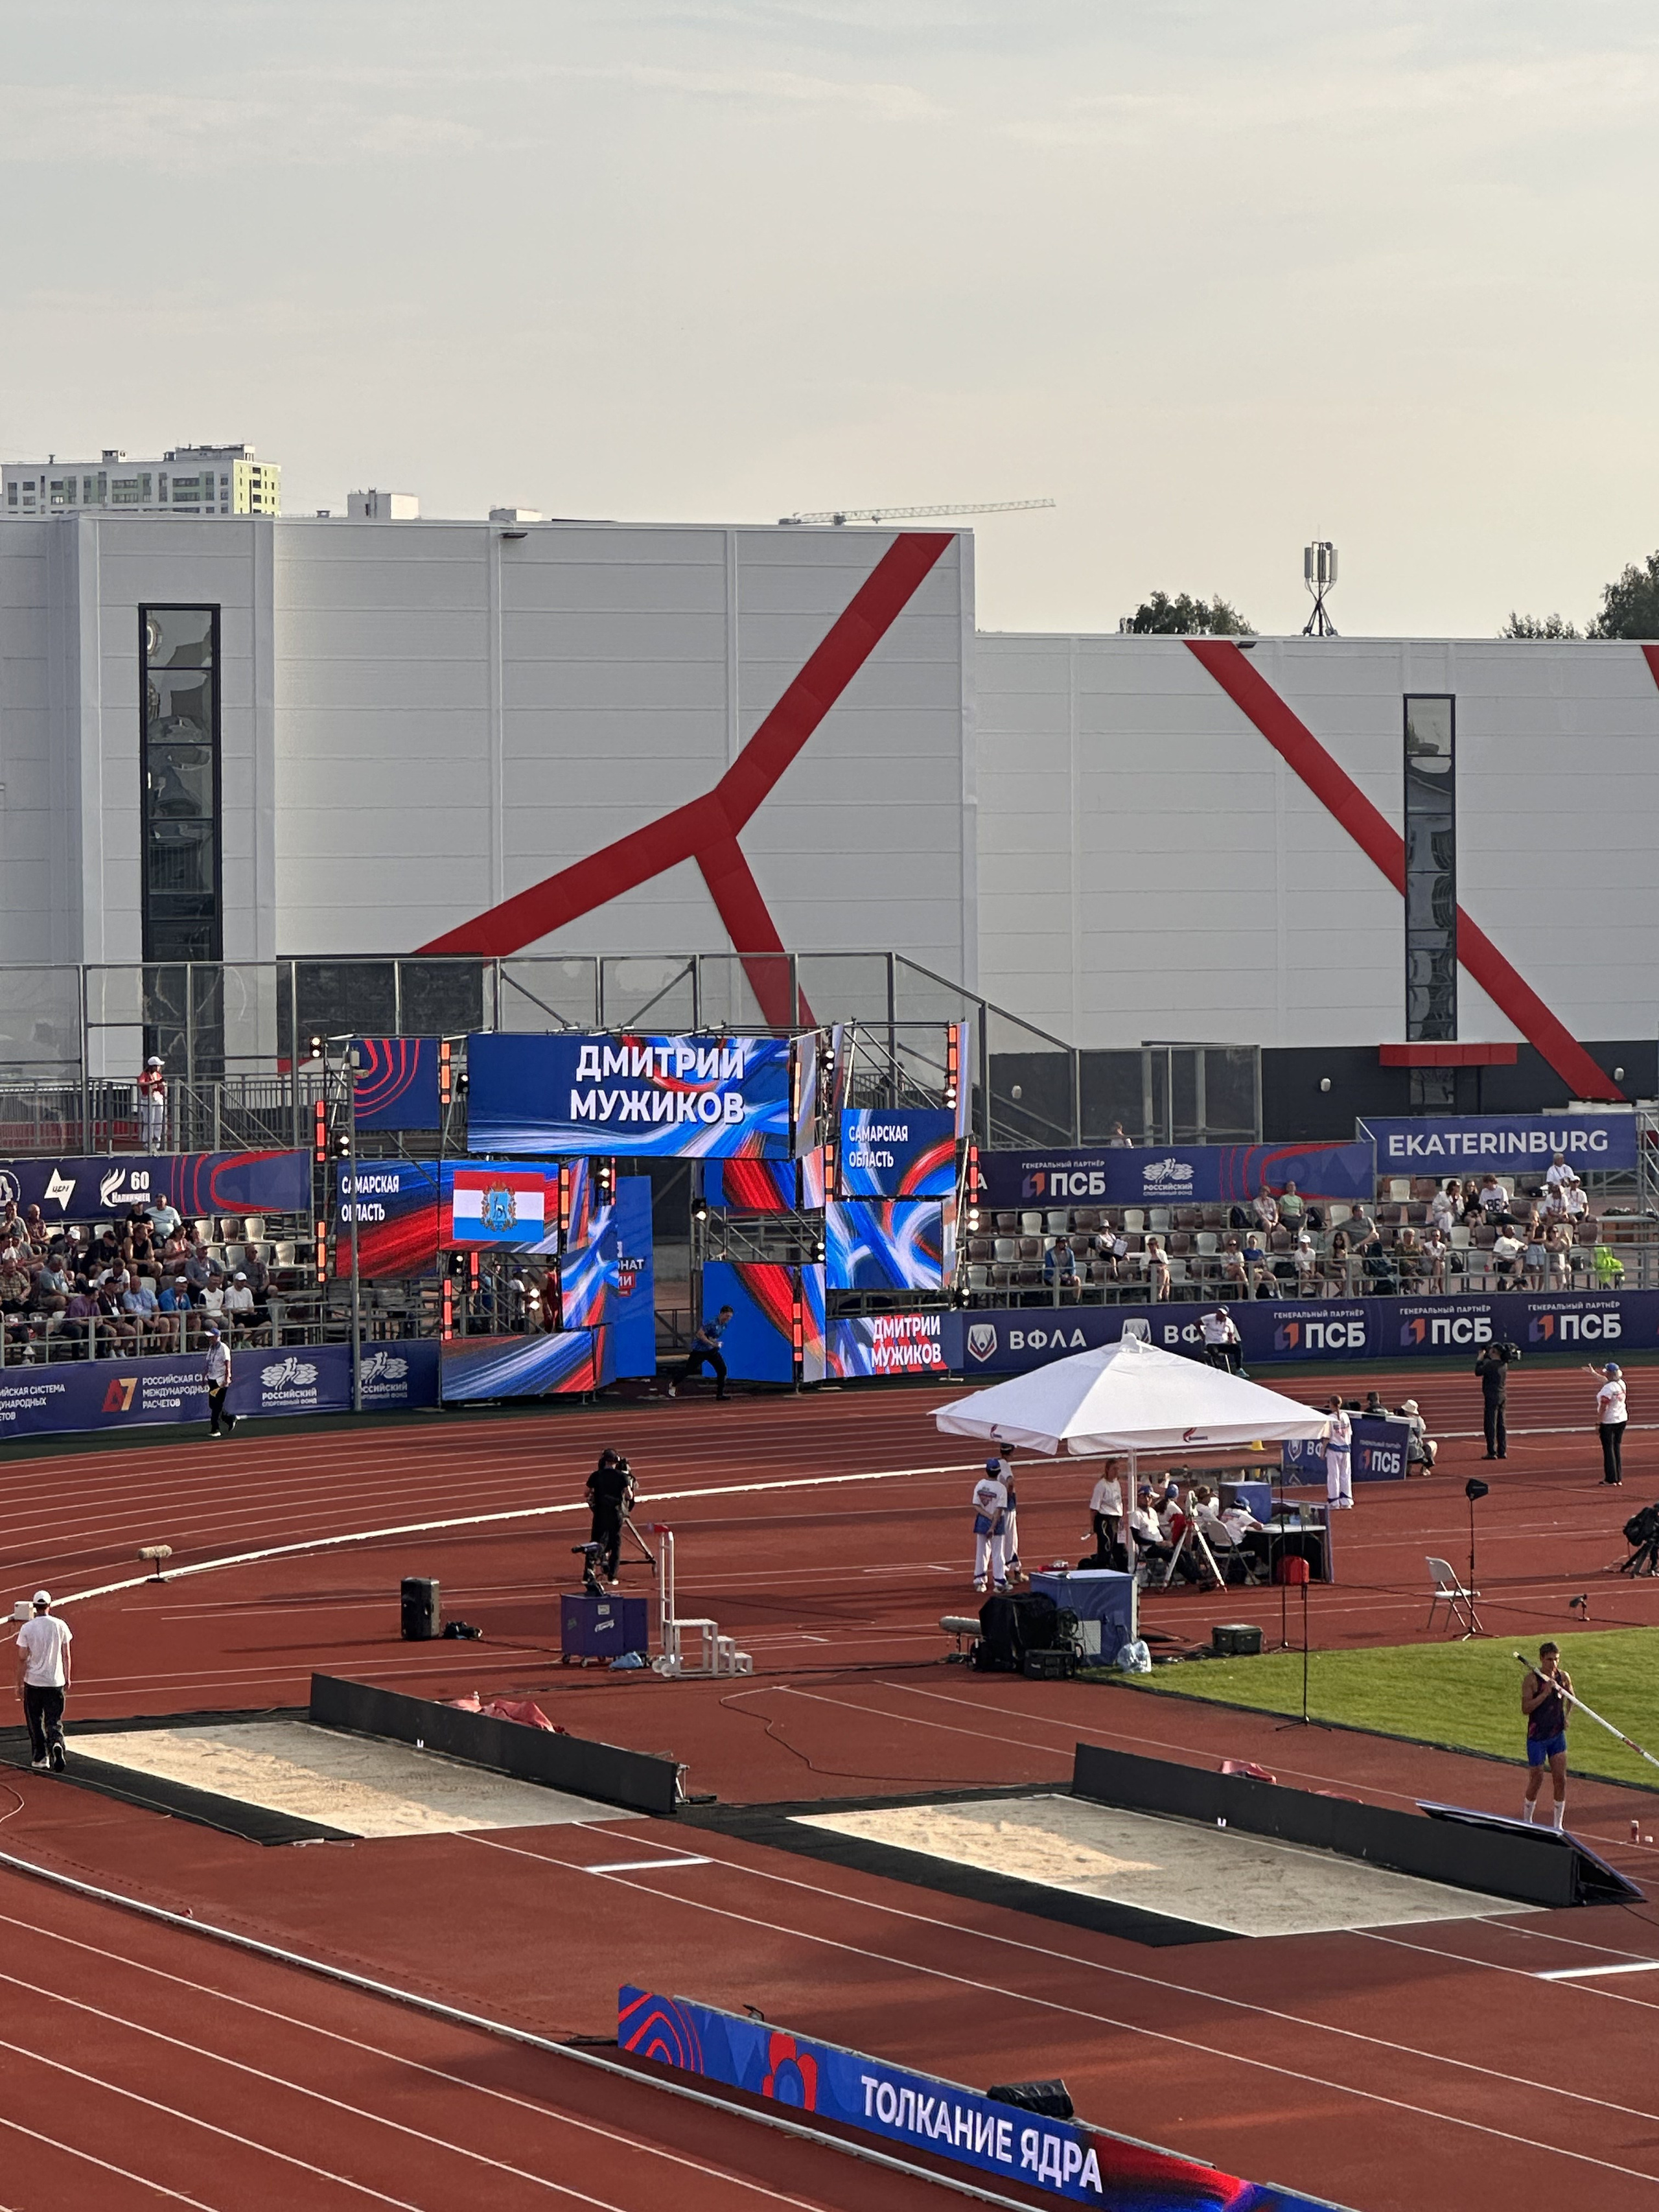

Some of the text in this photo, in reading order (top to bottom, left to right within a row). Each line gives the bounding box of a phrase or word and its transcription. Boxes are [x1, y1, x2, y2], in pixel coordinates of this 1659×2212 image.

[570, 1089, 745, 1124] МУЖИКОВ
[849, 1125, 908, 1142] САМАРСКАЯ
[1389, 1130, 1608, 1156] EKATERINBURG
[849, 1151, 894, 1167] ОБЛАСТЬ
[131, 1171, 150, 1190] 60
[1050, 1172, 1106, 1196] ПСБ
[1305, 1322, 1365, 1349] ПСБ
[1432, 1318, 1492, 1344] ПСБ
[1560, 1314, 1621, 1340] ПСБ
[1010, 1329, 1087, 1350] ВФЛА
[871, 1343, 942, 1368] МУЖИКОВ
[30, 1384, 65, 1394] СИСТЕМА
[262, 1387, 317, 1401] РОССИЙСКИЙ
[1372, 1451, 1400, 1474] ПСБ
[861, 2075, 1103, 2193] ТОЛКАНИЕ ЯДРА
